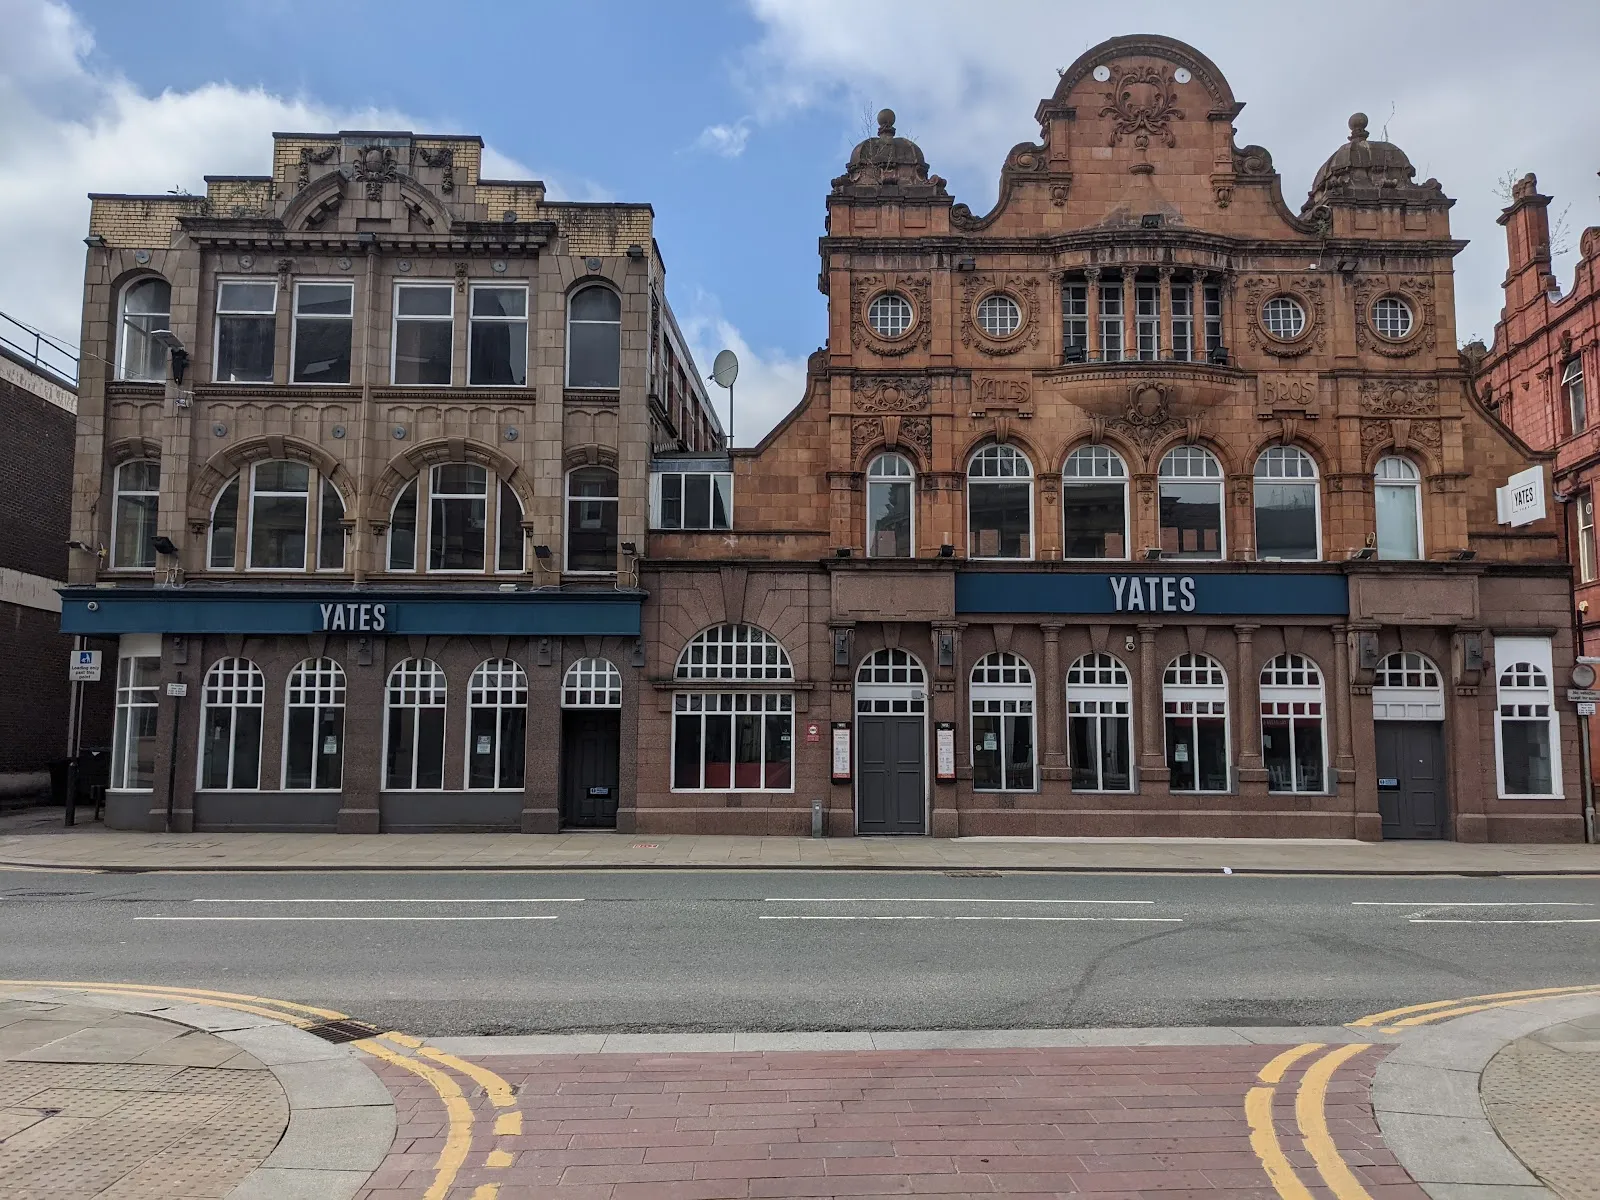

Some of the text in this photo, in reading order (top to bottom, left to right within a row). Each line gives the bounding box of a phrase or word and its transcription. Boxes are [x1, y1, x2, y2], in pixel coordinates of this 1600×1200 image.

[972, 377, 1031, 403] YATES
[1262, 379, 1315, 405] BROS
[1514, 487, 1534, 507] YATES
[1109, 576, 1196, 612] YATES
[319, 603, 386, 631] YATES
